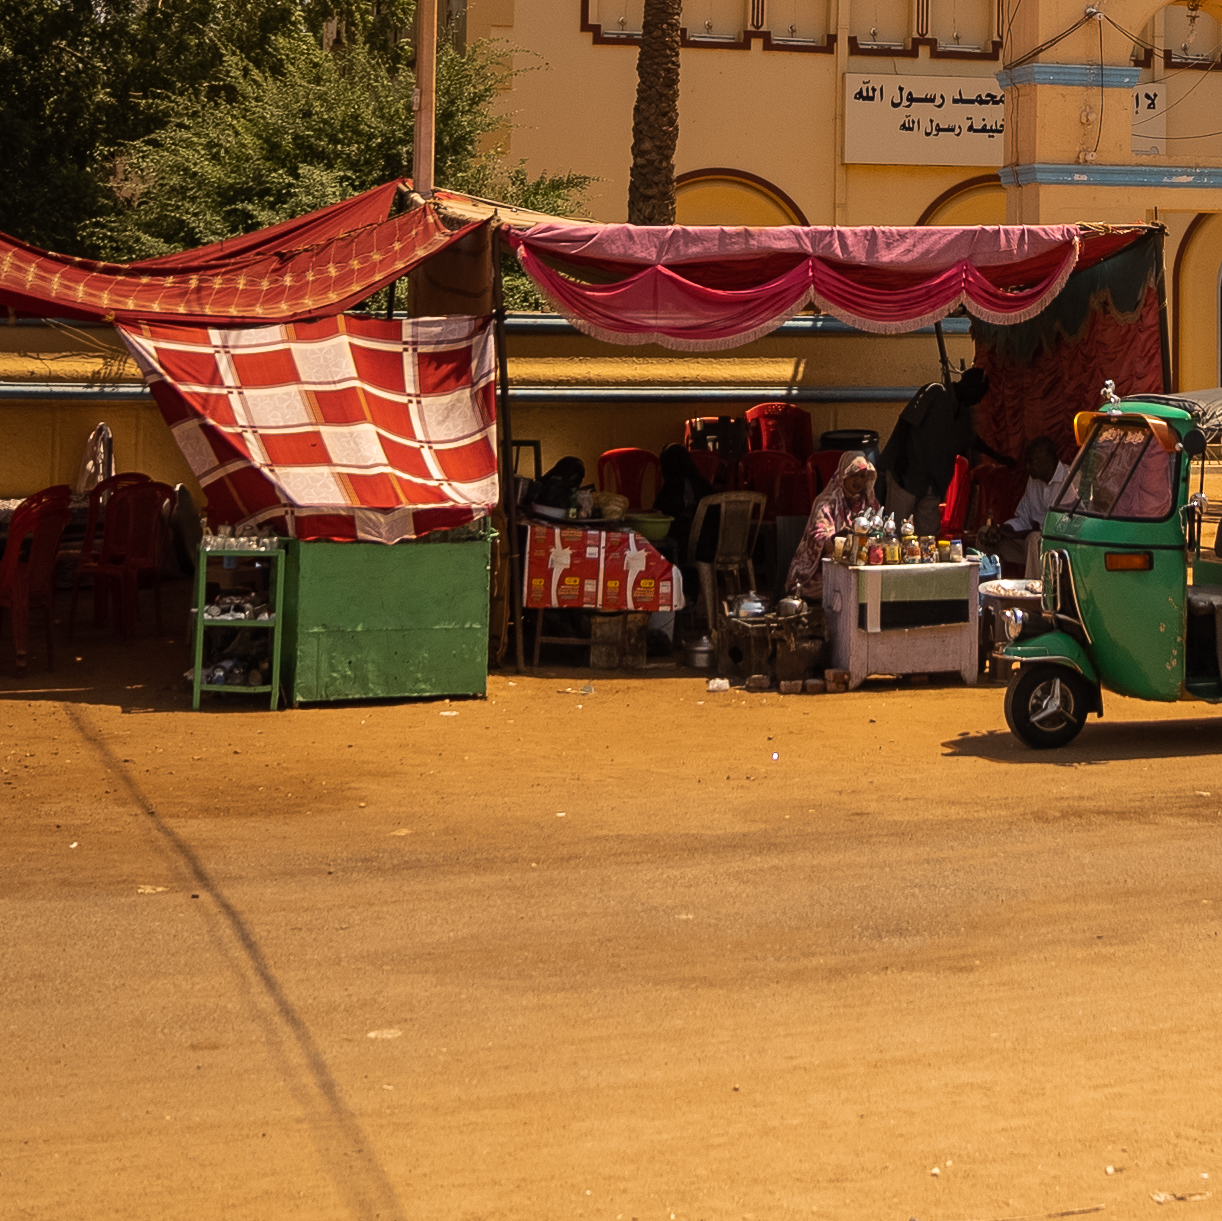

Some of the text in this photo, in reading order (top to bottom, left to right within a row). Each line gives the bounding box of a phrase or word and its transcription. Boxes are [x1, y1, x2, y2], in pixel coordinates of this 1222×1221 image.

[853, 79, 884, 103] الله
[890, 84, 945, 109] رسول
[899, 114, 921, 132] الله
[924, 118, 962, 137] رسول
